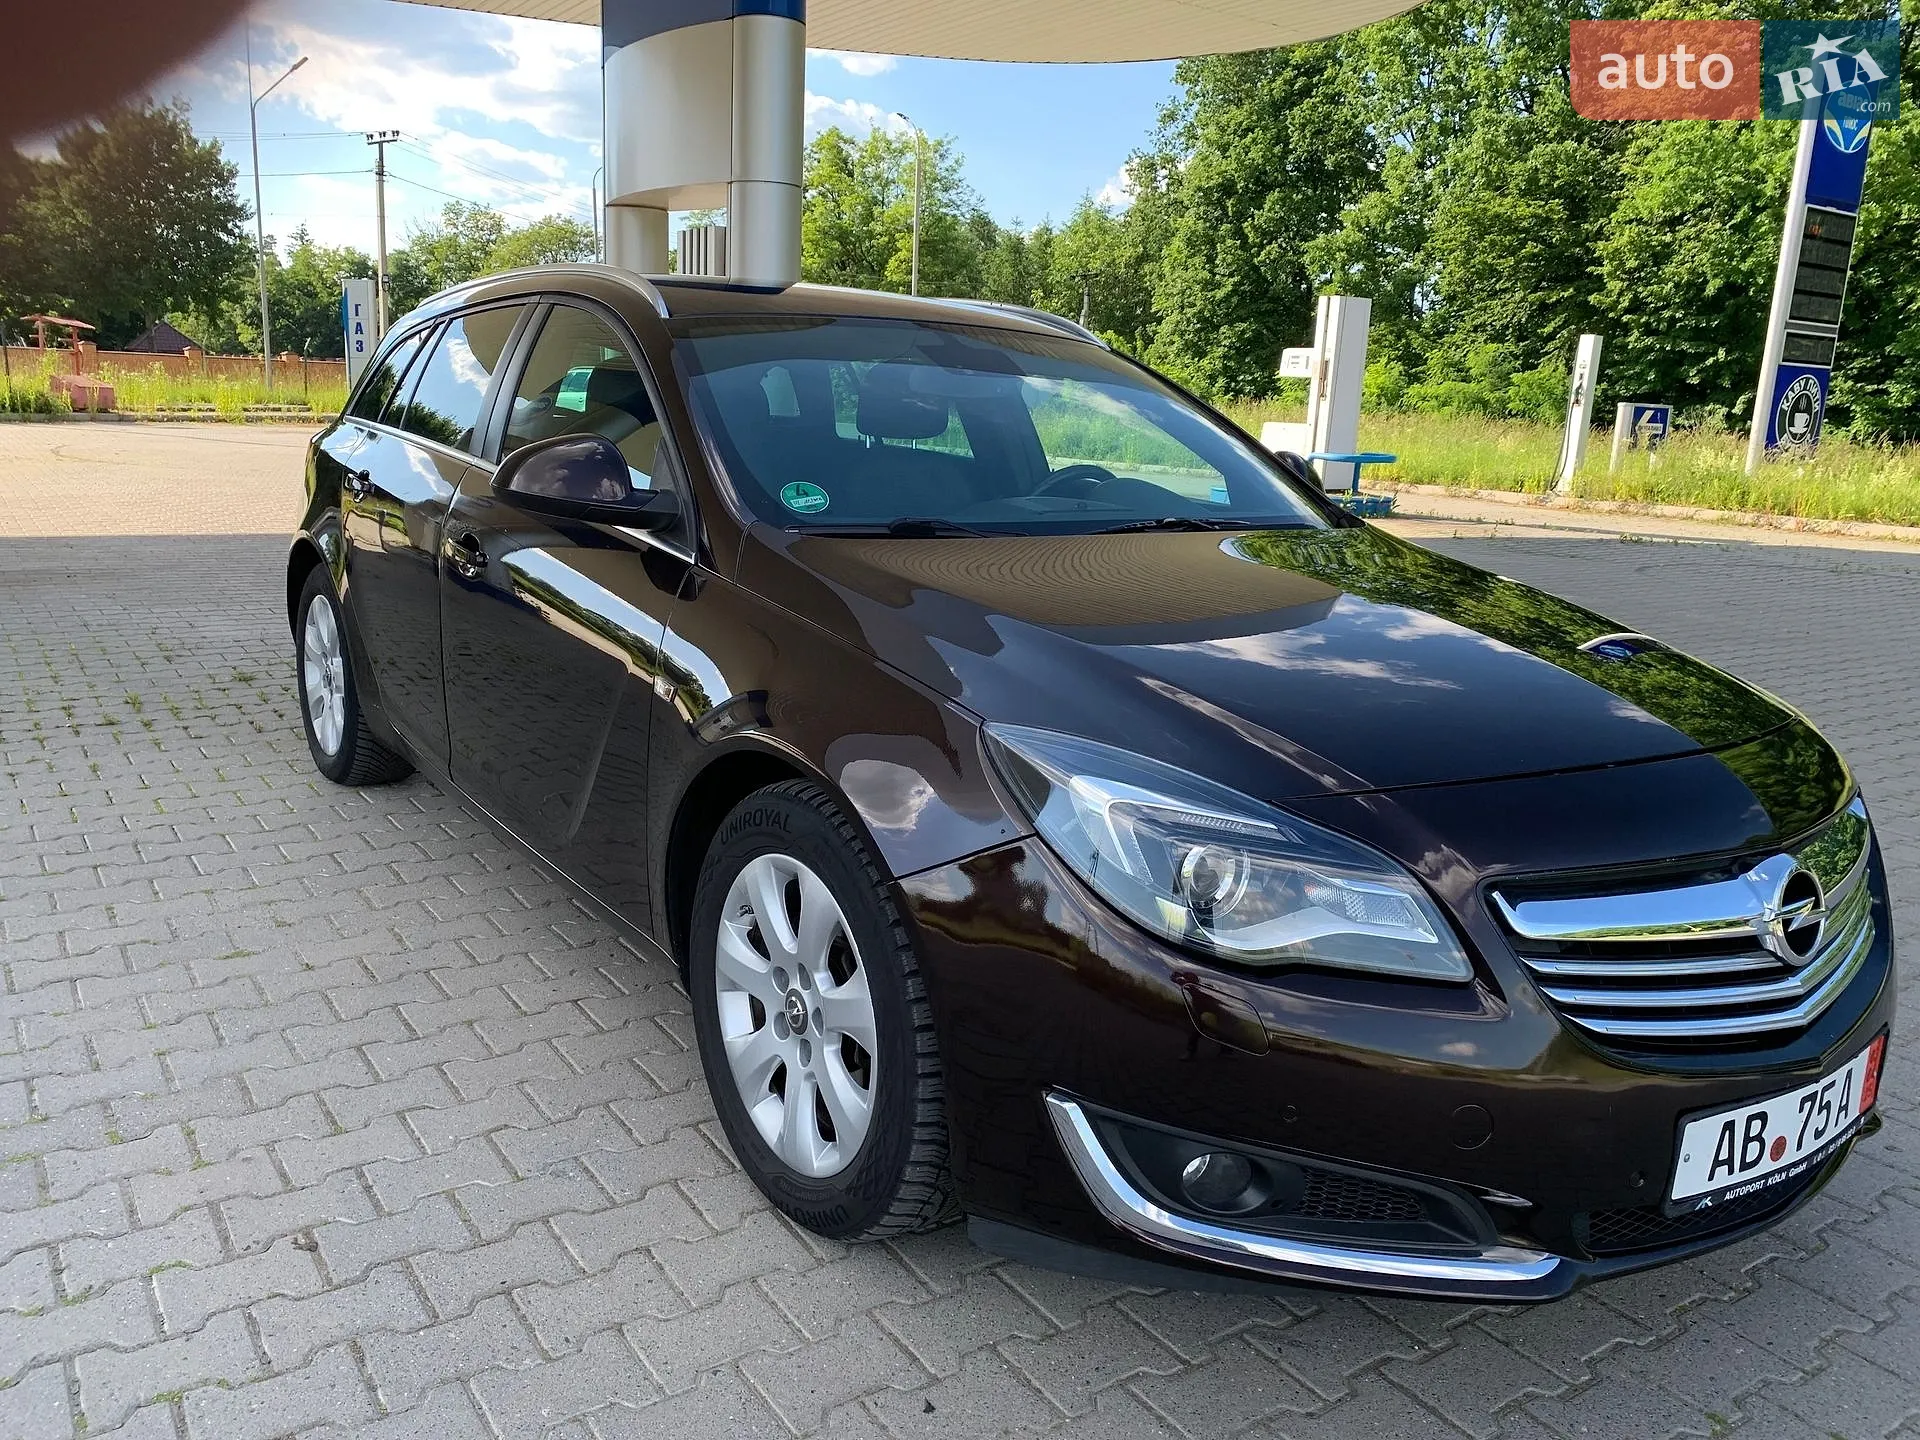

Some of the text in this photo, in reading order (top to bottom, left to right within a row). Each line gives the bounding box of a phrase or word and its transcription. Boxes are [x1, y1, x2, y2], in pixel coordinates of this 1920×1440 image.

[354, 303, 364, 353] ГАЗ
[1781, 378, 1807, 411] КАВУ
[720, 807, 793, 846] UNIROYAL
[1707, 1110, 1769, 1182] AB
[1795, 1067, 1853, 1153] 75A
[1723, 1161, 1808, 1202] AUTOPORT KÖLN GmbH
